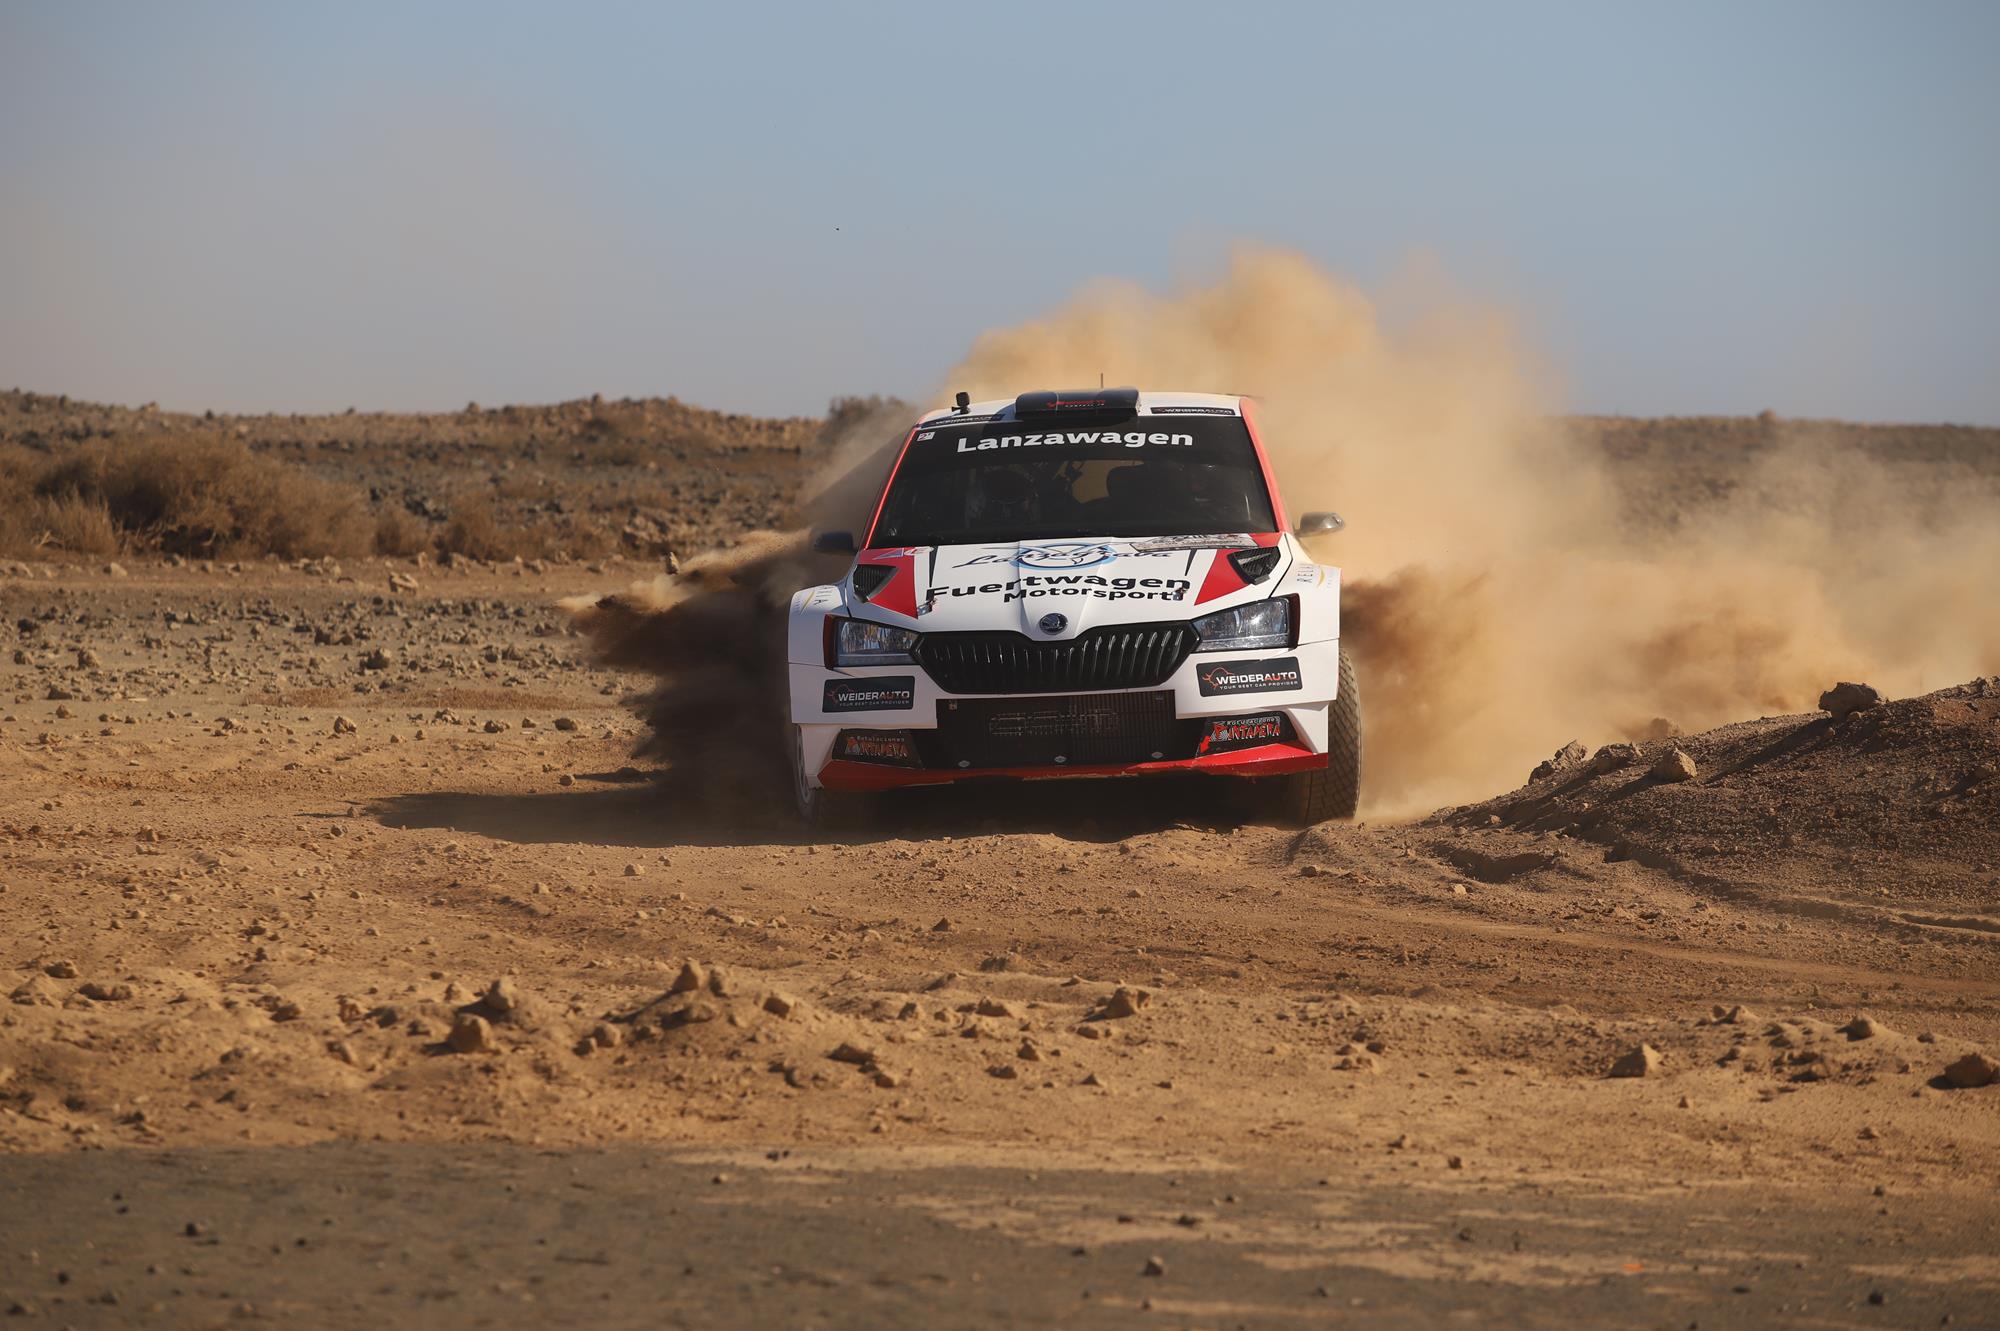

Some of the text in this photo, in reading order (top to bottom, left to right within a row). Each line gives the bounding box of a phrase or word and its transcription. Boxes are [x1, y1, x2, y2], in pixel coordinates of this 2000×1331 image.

[957, 432, 1193, 453] Lanzawagen
[925, 575, 1191, 601] Fuertwagen
[1003, 586, 1173, 603] Motorsport
[1216, 671, 1297, 685] WEIDERAUTO
[838, 690, 910, 702] WEIDERAUTO
